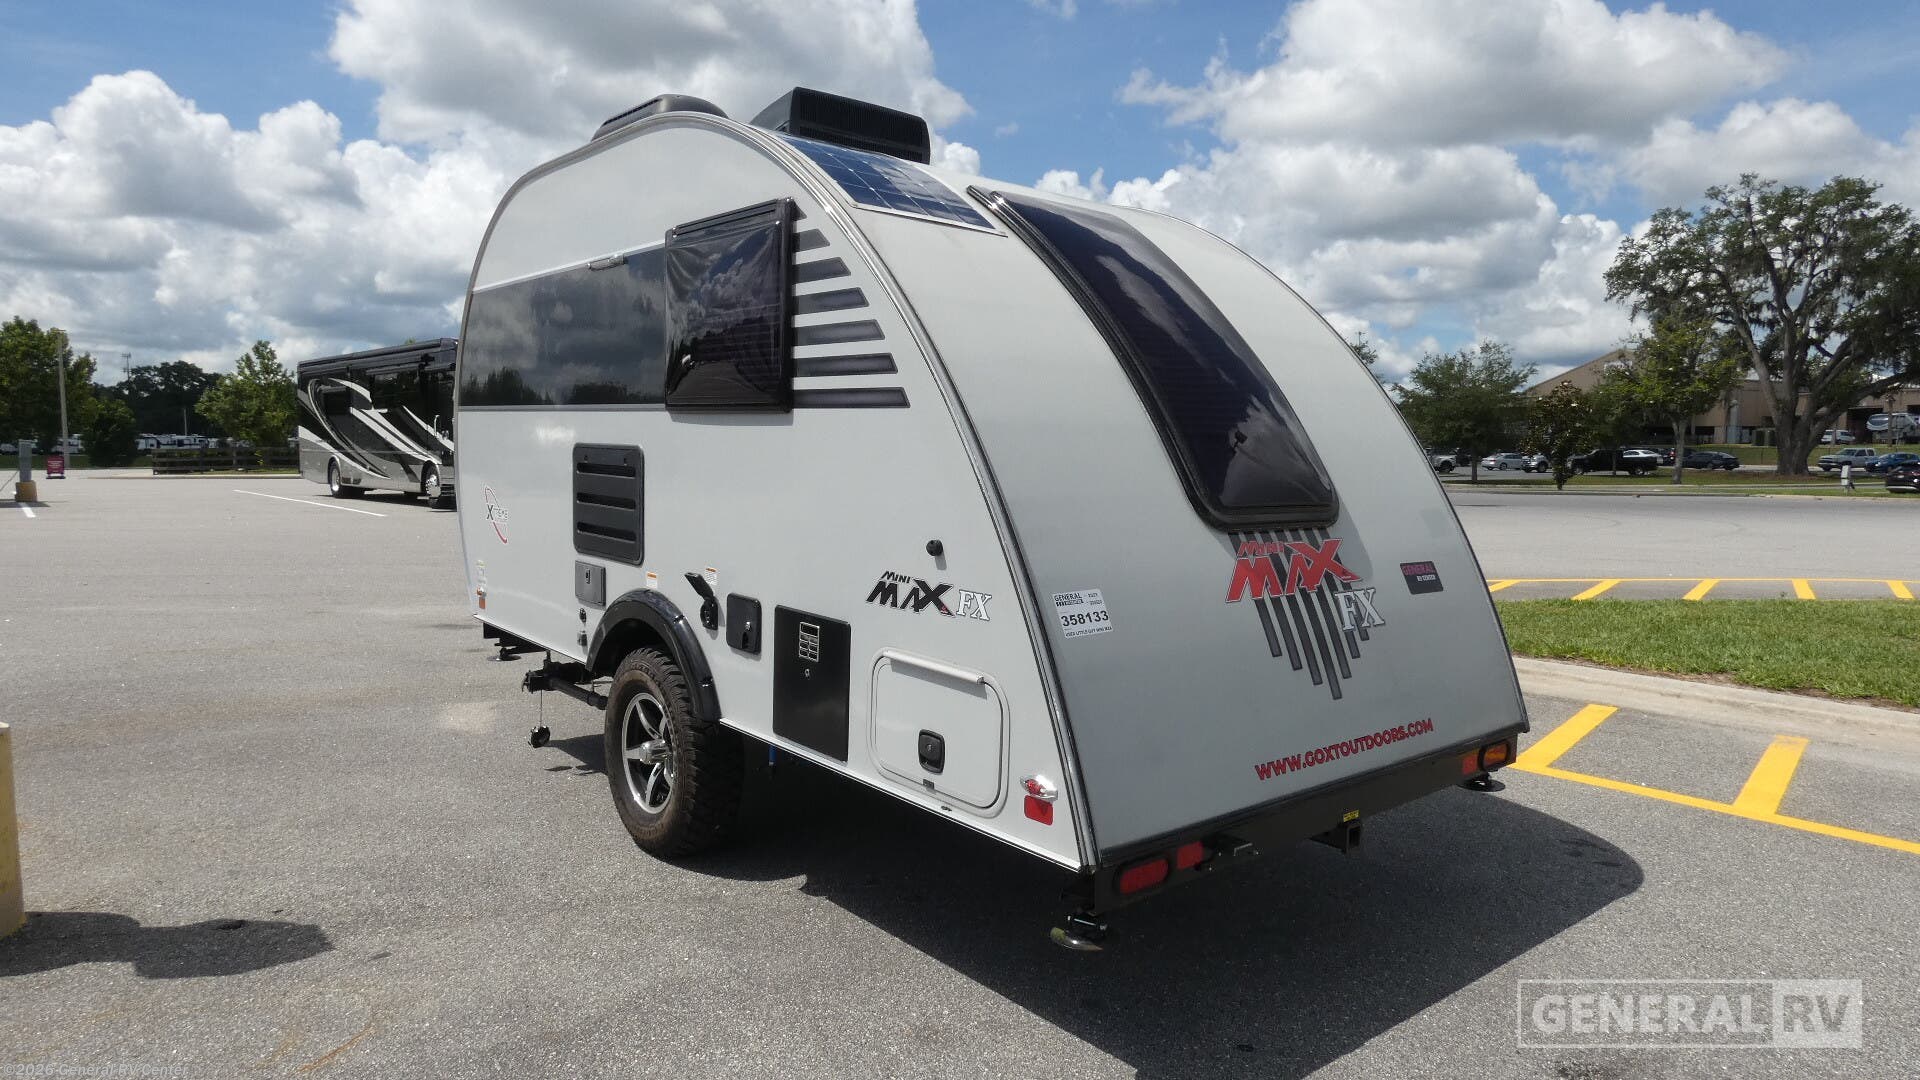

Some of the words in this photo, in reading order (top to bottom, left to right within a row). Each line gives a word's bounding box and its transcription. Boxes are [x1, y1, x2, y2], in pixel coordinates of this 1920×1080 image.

[881, 571, 910, 583] MINI
[1225, 538, 1362, 603] MAX
[865, 578, 954, 617] MAX
[956, 589, 992, 621] FX
[1060, 610, 1109, 627] 358133
[1334, 588, 1385, 631] FX
